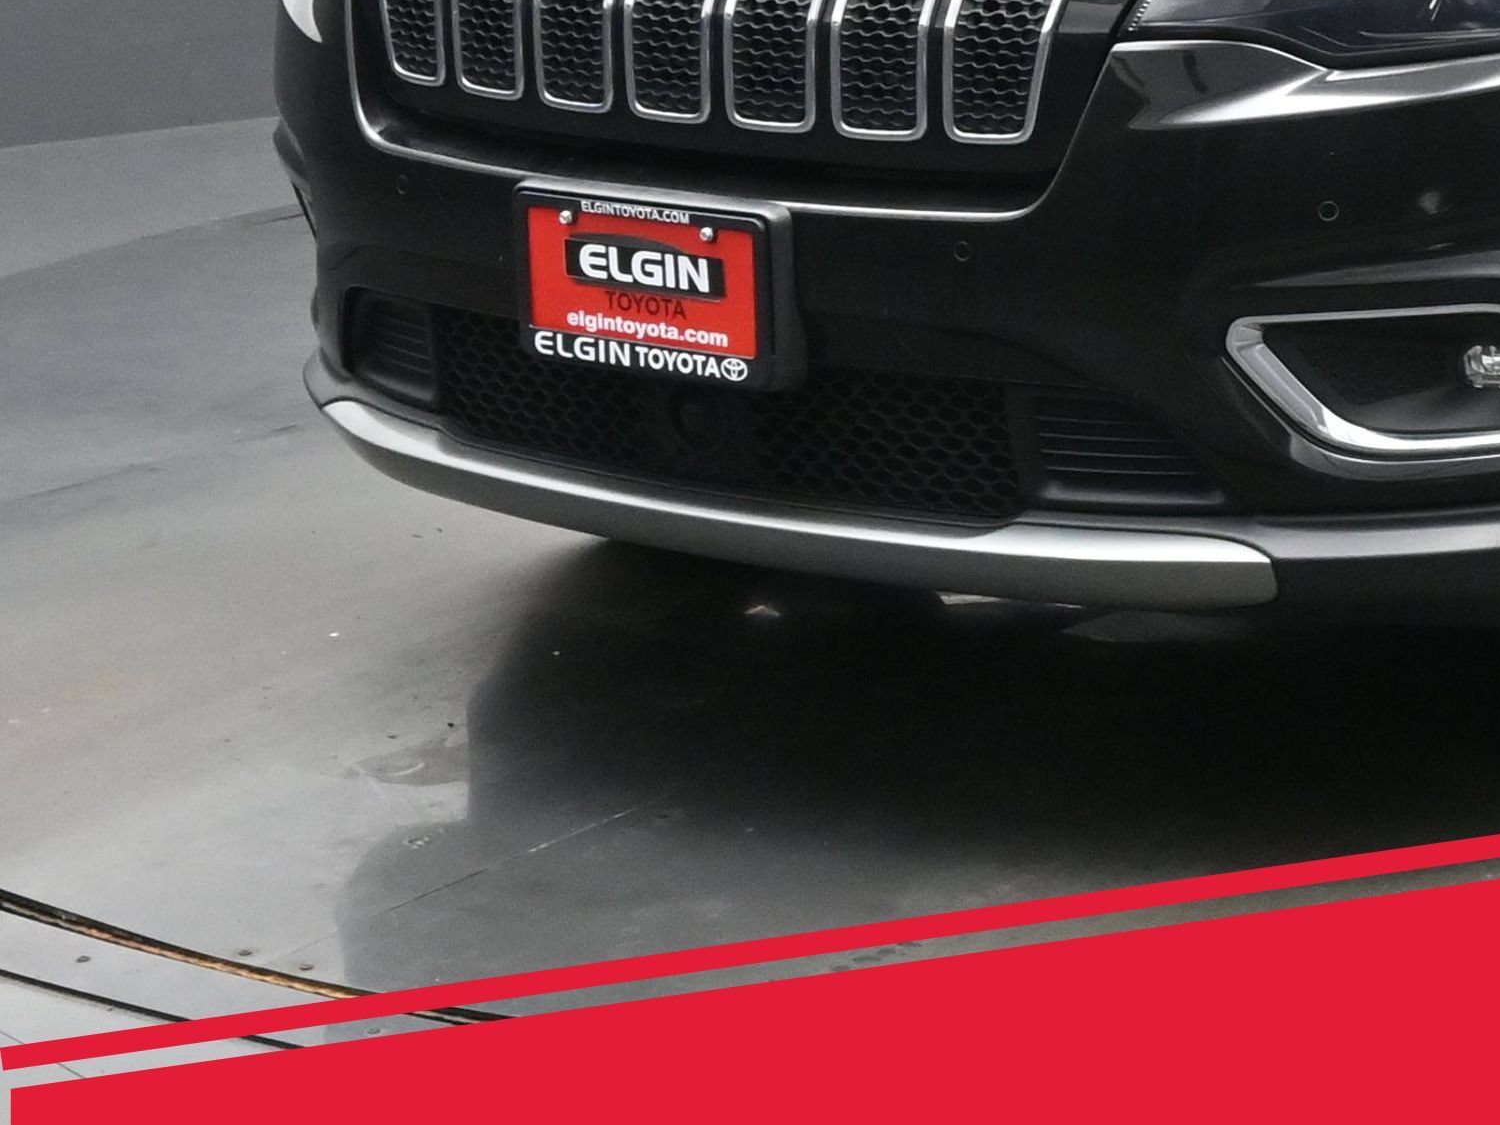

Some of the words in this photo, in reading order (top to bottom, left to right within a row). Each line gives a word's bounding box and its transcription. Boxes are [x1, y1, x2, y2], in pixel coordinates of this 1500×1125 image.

[581, 201, 690, 224] ELGINTOYOTA.COM
[578, 244, 710, 292] ELGIN
[606, 292, 686, 319] TOYOTA
[567, 311, 728, 347] elgintoyota.com
[534, 331, 631, 367] ELGIN
[635, 346, 721, 379] TOYOTA
